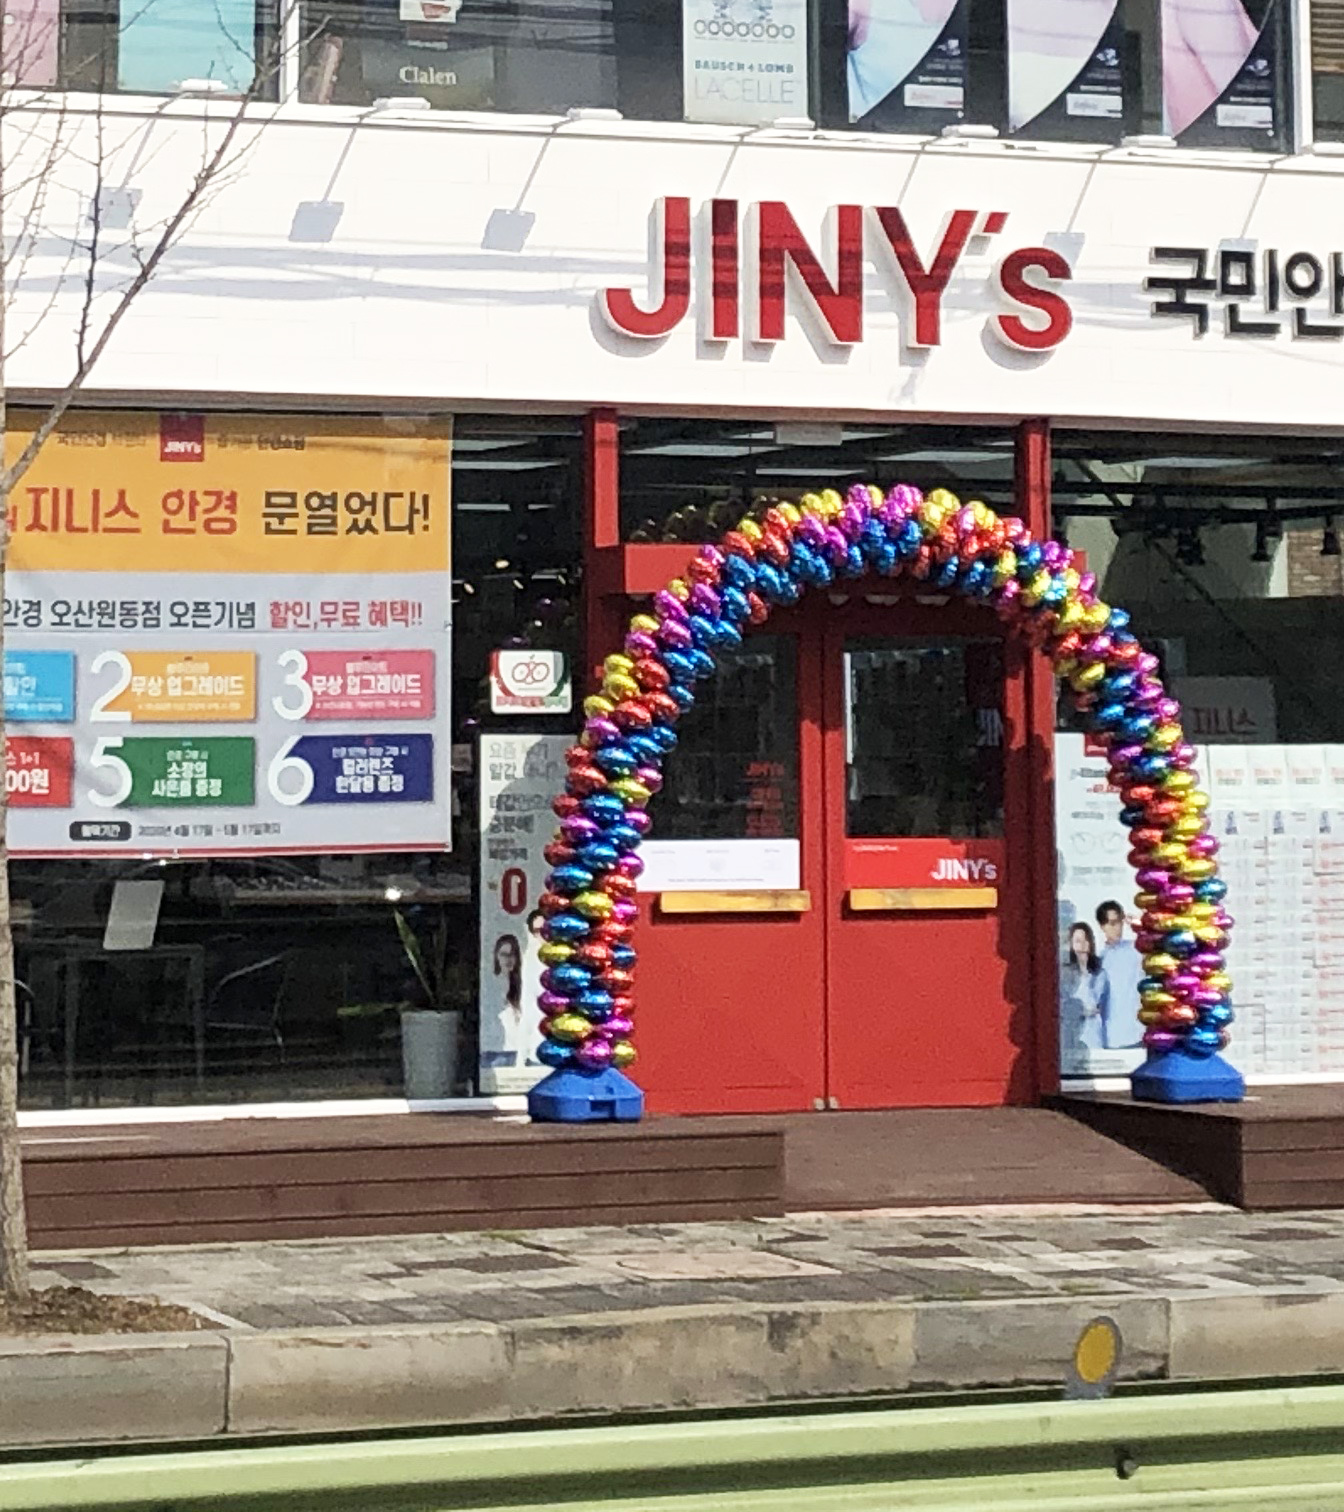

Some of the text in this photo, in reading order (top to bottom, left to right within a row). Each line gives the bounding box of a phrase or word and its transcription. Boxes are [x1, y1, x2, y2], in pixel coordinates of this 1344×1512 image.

[399, 66, 457, 85] Clalen
[695, 60, 745, 72] BAUSCH
[758, 63, 794, 73] LOMB
[695, 75, 795, 104] LACELLE
[605, 196, 1074, 352] JINY's
[25, 487, 140, 533] 지니스
[161, 489, 238, 535] 안경
[261, 490, 429, 535] 문열었다!
[50, 599, 161, 629] 오산원동점
[169, 600, 256, 629] 오픈기념
[269, 600, 360, 630] 할인,무료
[367, 599, 423, 628] 혜택!!
[89, 650, 133, 723] 2
[131, 675, 245, 697] 무상 업그레이드
[272, 649, 313, 720] 3
[312, 674, 421, 696] 무상 업그레이드
[87, 737, 133, 808] 5
[268, 735, 314, 806] 6
[930, 858, 998, 880] JINY's
